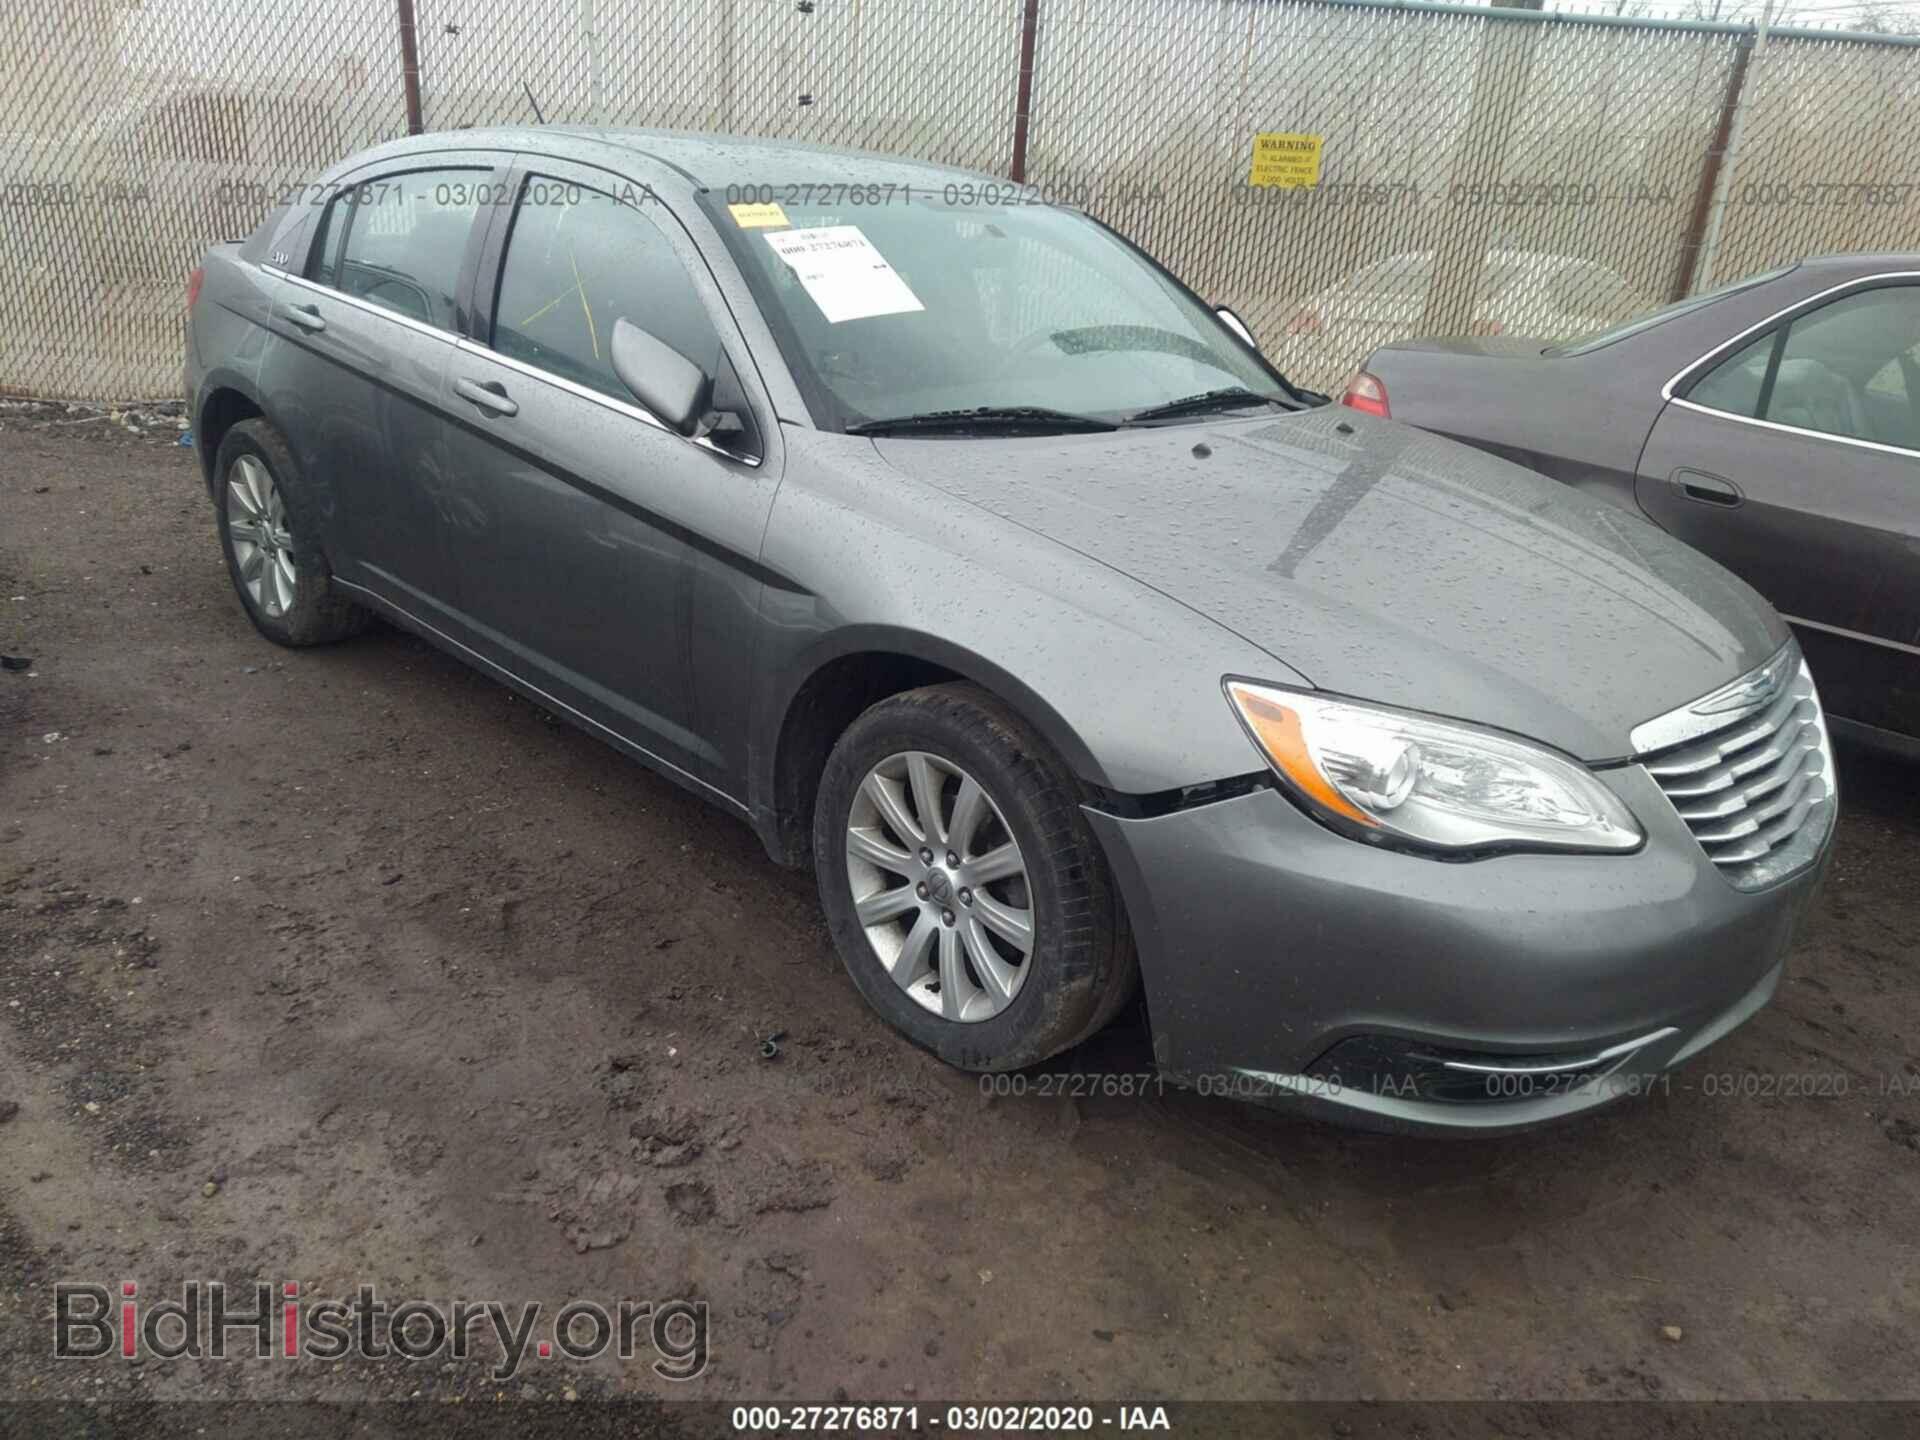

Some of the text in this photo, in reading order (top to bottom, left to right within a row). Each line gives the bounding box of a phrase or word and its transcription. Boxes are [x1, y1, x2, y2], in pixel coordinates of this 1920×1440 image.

[1261, 138, 1315, 150] WARNING
[1256, 164, 1313, 175] ELECTRIC FENCE
